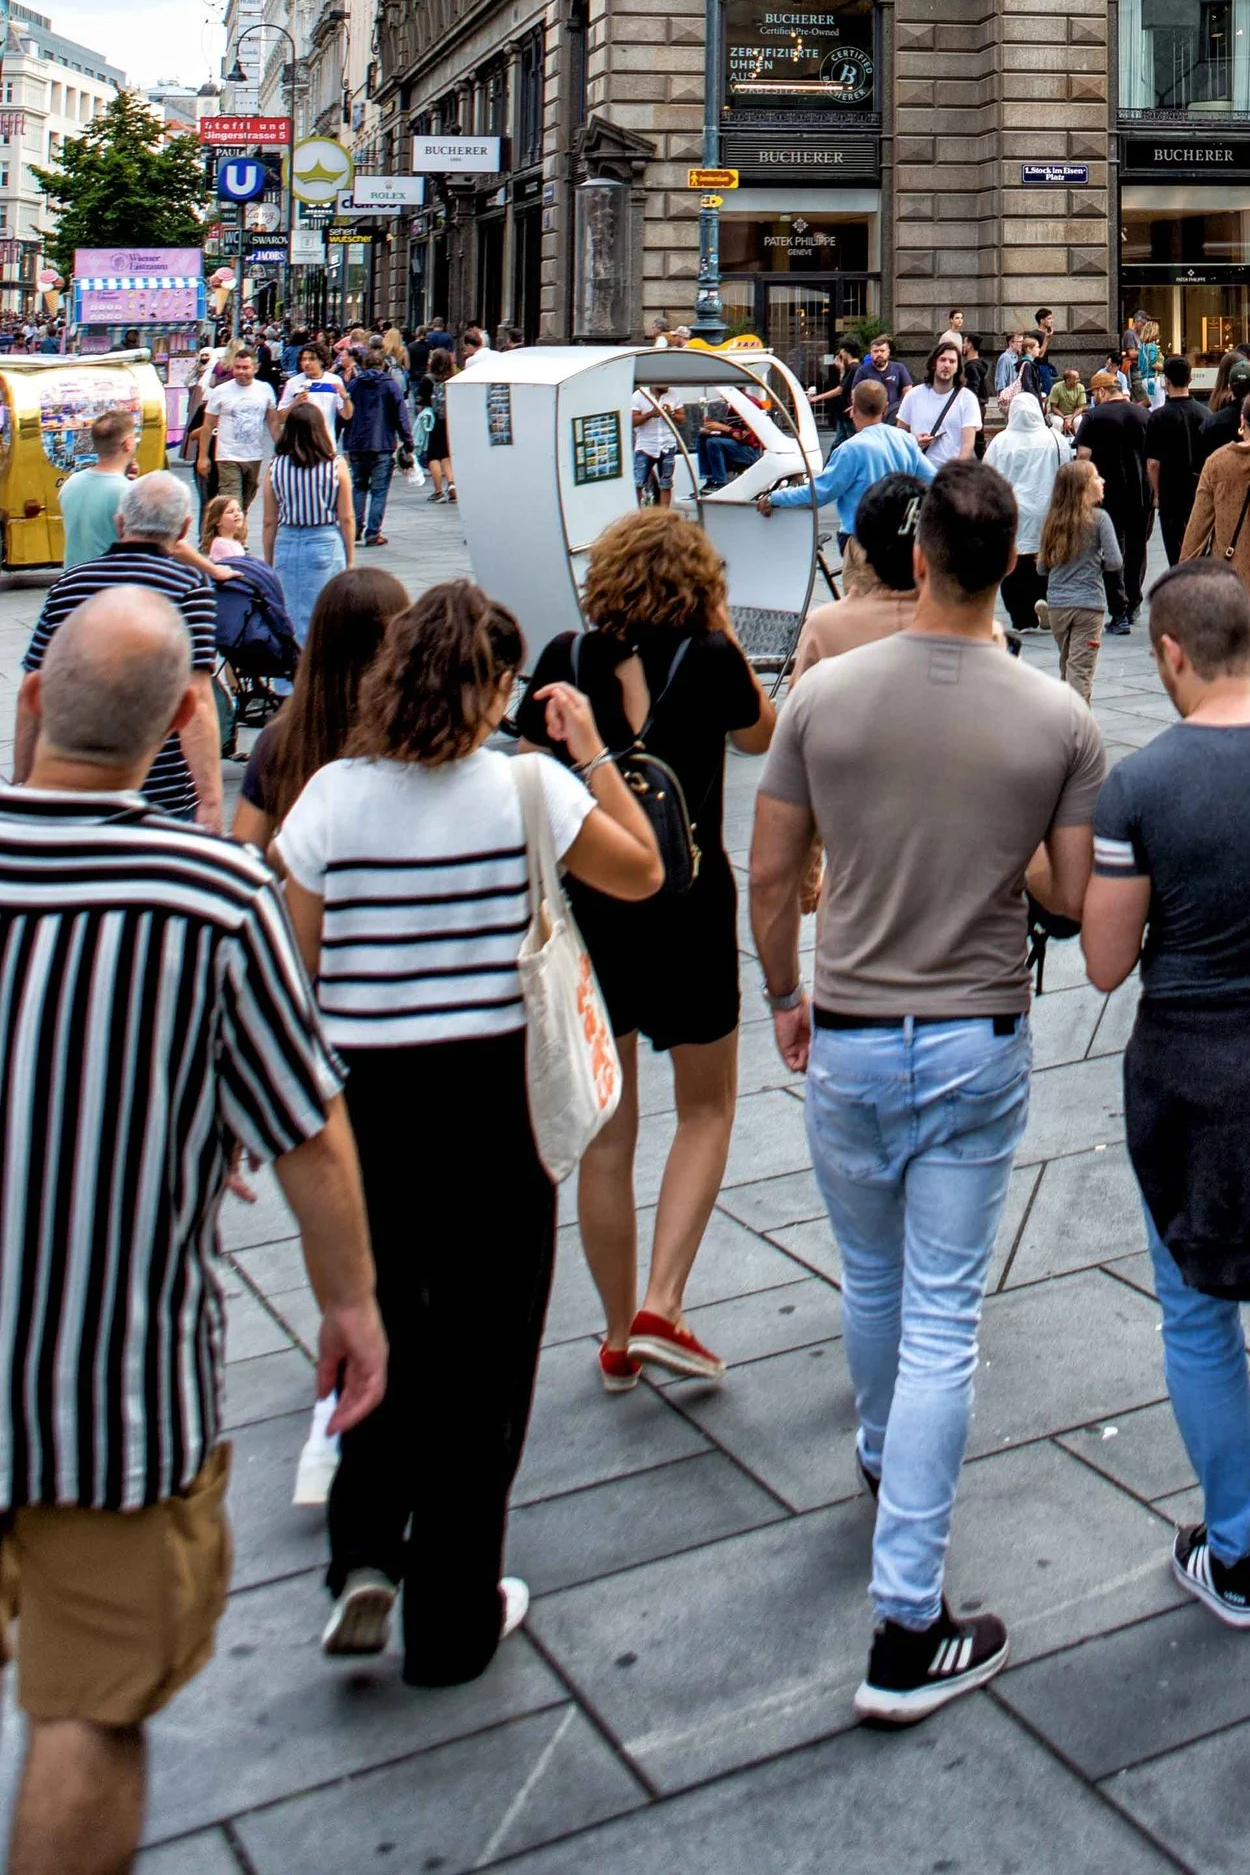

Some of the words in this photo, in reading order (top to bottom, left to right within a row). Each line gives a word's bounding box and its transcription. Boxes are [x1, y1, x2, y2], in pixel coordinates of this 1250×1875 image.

[765, 13, 835, 25] BUCHERER
[759, 26, 794, 36] Certified
[795, 27, 840, 37] Pre-Owned
[730, 47, 820, 59] ZERTIFIZIERTE
[730, 60, 774, 70] UHREN
[831, 49, 873, 75] CERTIFIED
[204, 121, 251, 130] Steffl
[259, 121, 287, 130] und
[279, 131, 287, 140] 5
[215, 148, 242, 157] PAUL
[425, 146, 488, 155] BUCHERER
[1154, 148, 1235, 162] BUCHERER
[758, 151, 844, 164] BUCHERER
[226, 165, 257, 195] U
[1045, 173, 1065, 181] Platz
[370, 191, 406, 200] ROLEX
[225, 231, 240, 244] WC
[329, 235, 373, 244] wutscher
[764, 236, 793, 246] PATEK
[795, 236, 837, 247] PHILIPPE
[129, 253, 161, 262] Wiener
